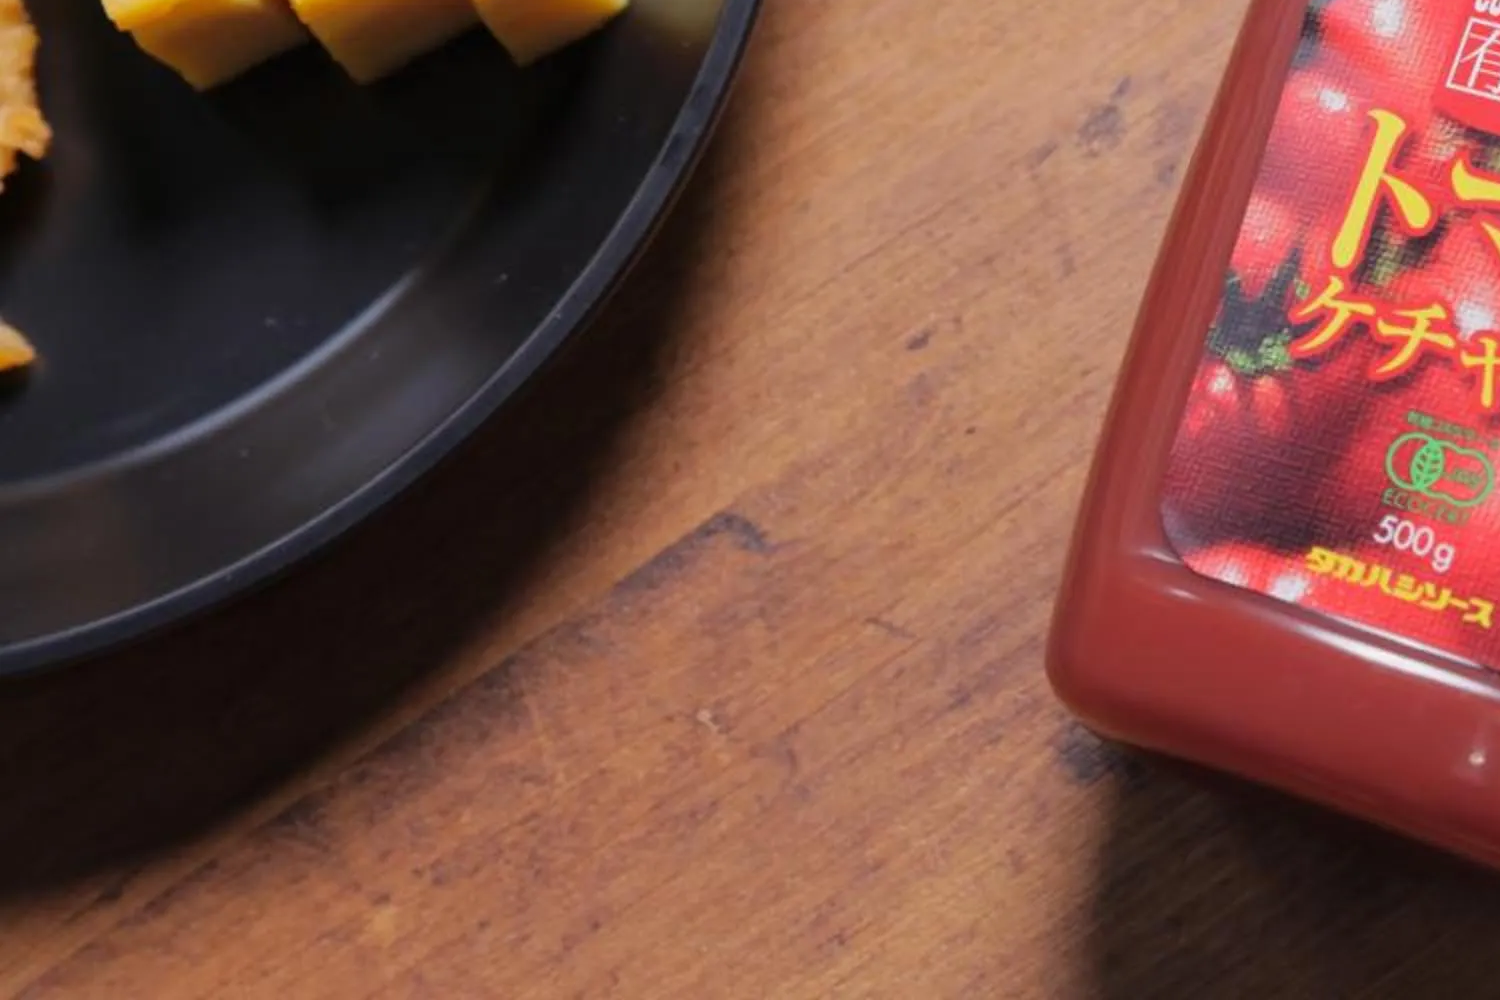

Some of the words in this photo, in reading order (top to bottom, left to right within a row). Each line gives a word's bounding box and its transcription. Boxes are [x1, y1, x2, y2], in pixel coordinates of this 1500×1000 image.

[1304, 545, 1495, 630] タカハシソース
